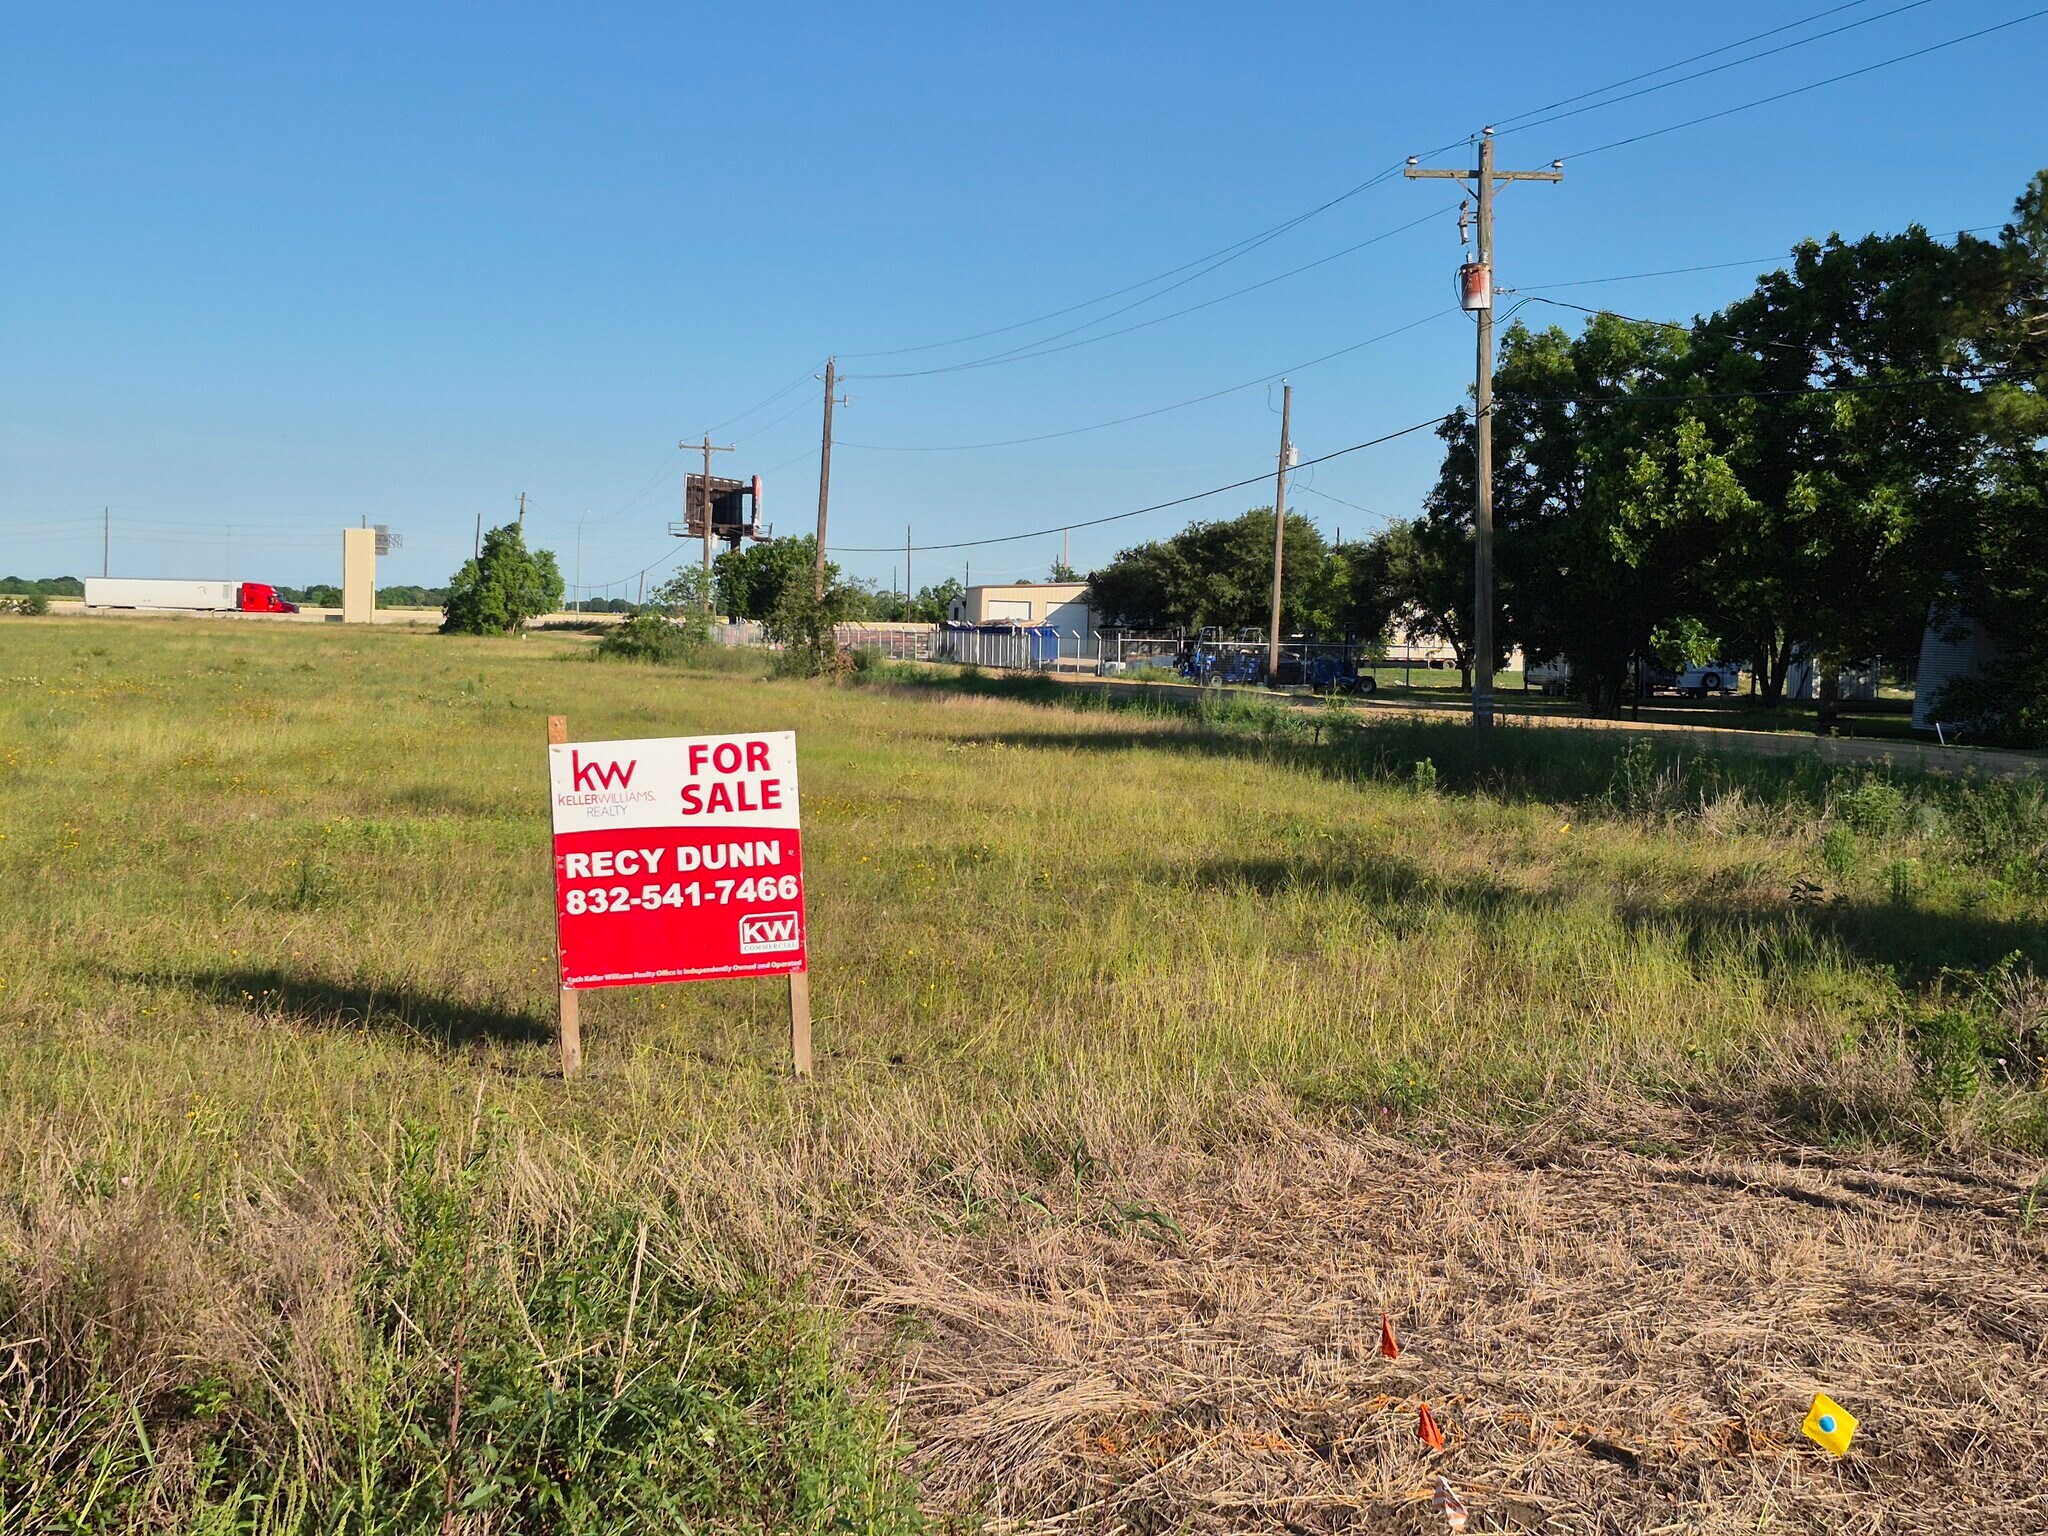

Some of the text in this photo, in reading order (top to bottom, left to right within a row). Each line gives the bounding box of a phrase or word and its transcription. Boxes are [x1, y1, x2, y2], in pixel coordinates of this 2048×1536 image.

[572, 749, 637, 792] kw
[688, 741, 771, 776] FOR
[586, 804, 628, 818] REALTY
[680, 779, 782, 815] SALE
[566, 840, 780, 879] RECY DUNN
[565, 875, 798, 915] 832-541-7466
[743, 919, 794, 943] KW
[743, 942, 796, 951] COMMERCIAL
[584, 974, 604, 982] Keller
[633, 971, 656, 979] Realty
[656, 969, 676, 977] Office
[683, 965, 732, 975] Independently
[732, 963, 756, 971] Owned
[770, 960, 802, 969] Operated
